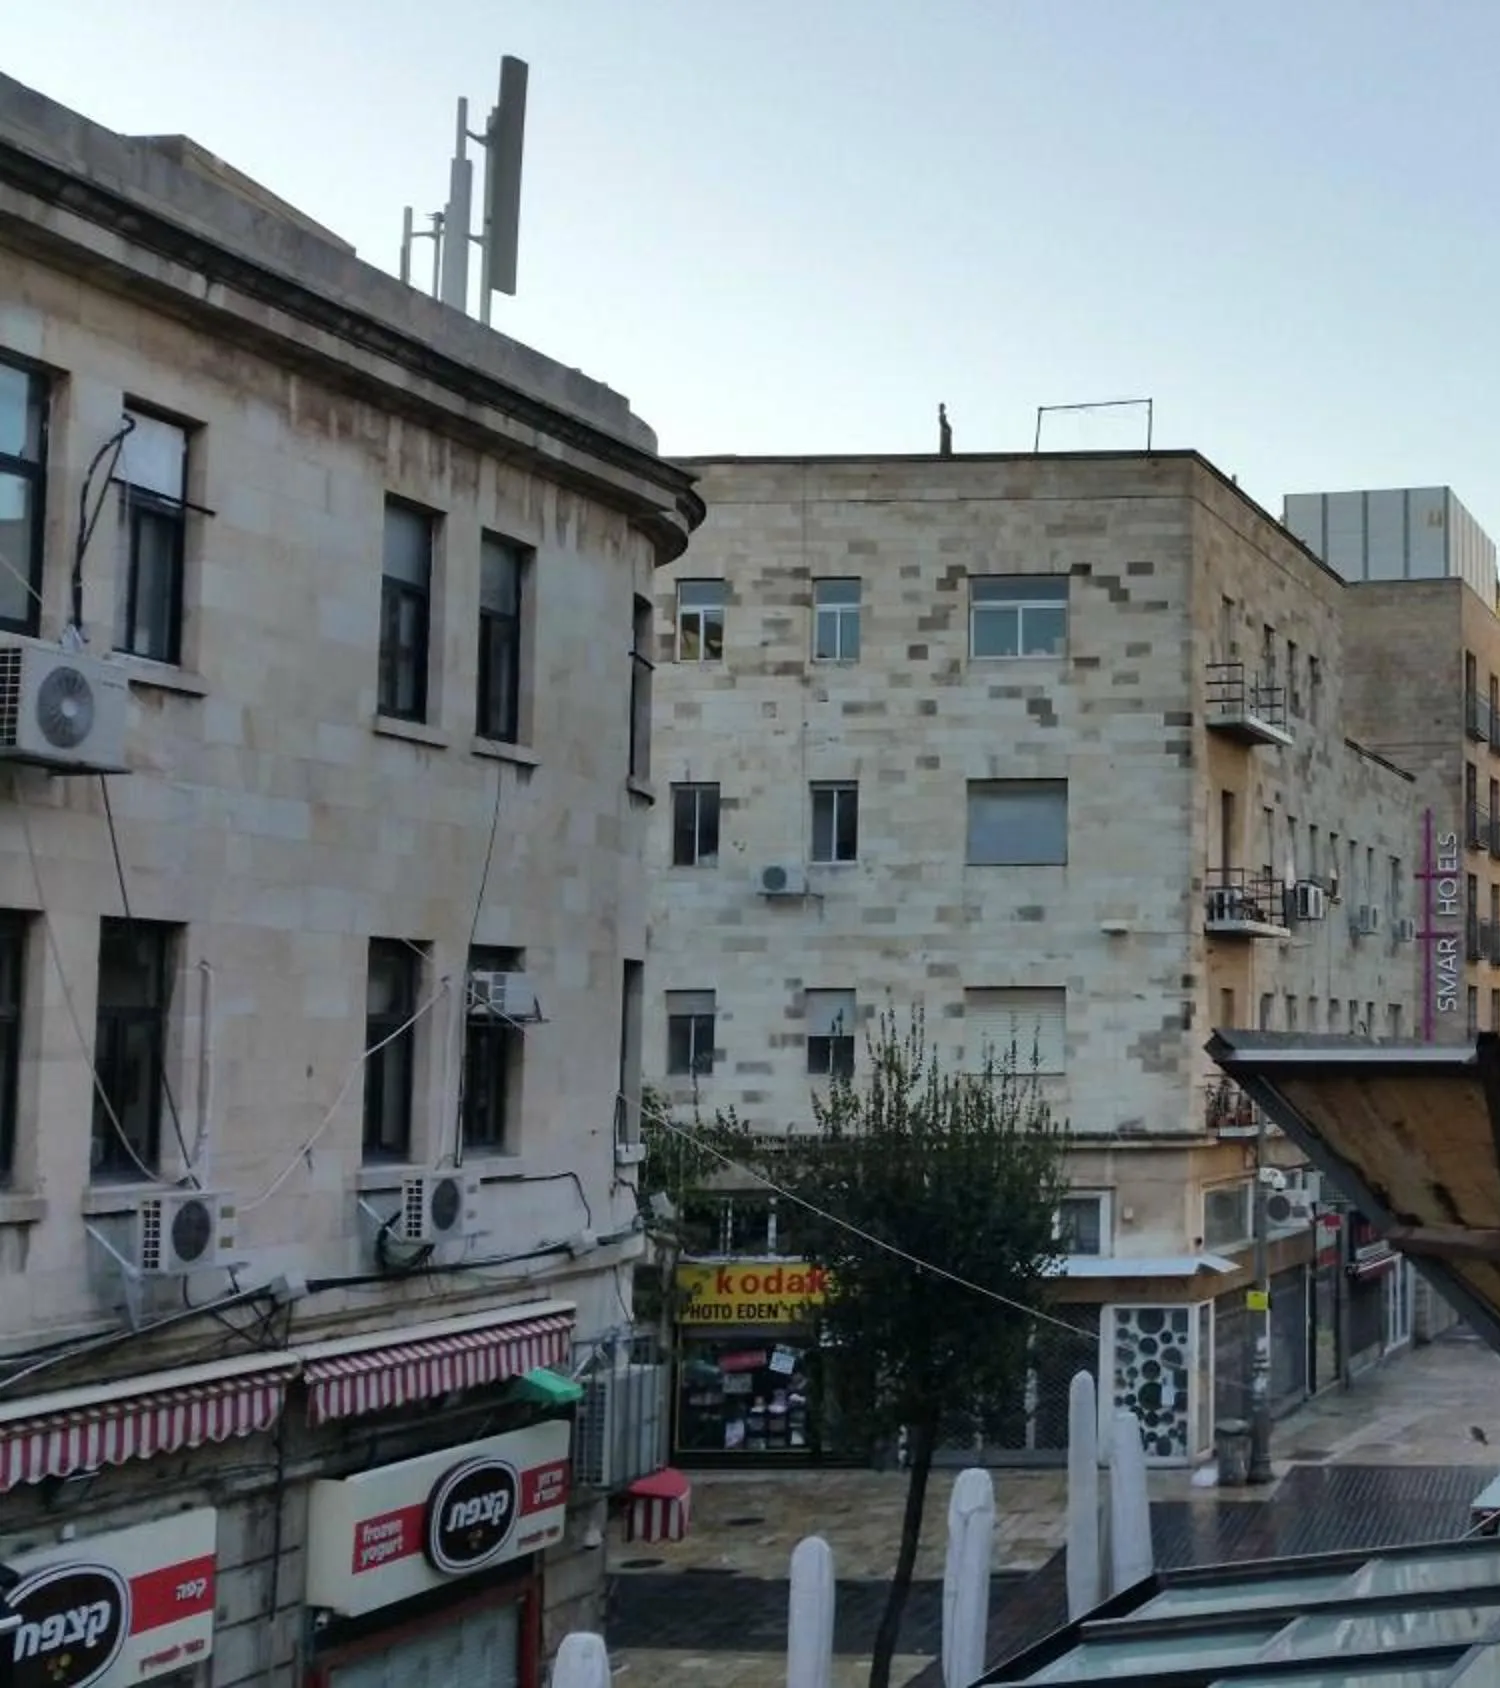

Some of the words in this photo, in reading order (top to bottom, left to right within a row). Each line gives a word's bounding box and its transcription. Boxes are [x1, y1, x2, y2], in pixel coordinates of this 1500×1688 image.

[679, 1303, 733, 1320] PHOTO
[736, 1302, 779, 1320] EDEN
[446, 1488, 509, 1533] קצפת
[175, 1577, 207, 1601] קפה
